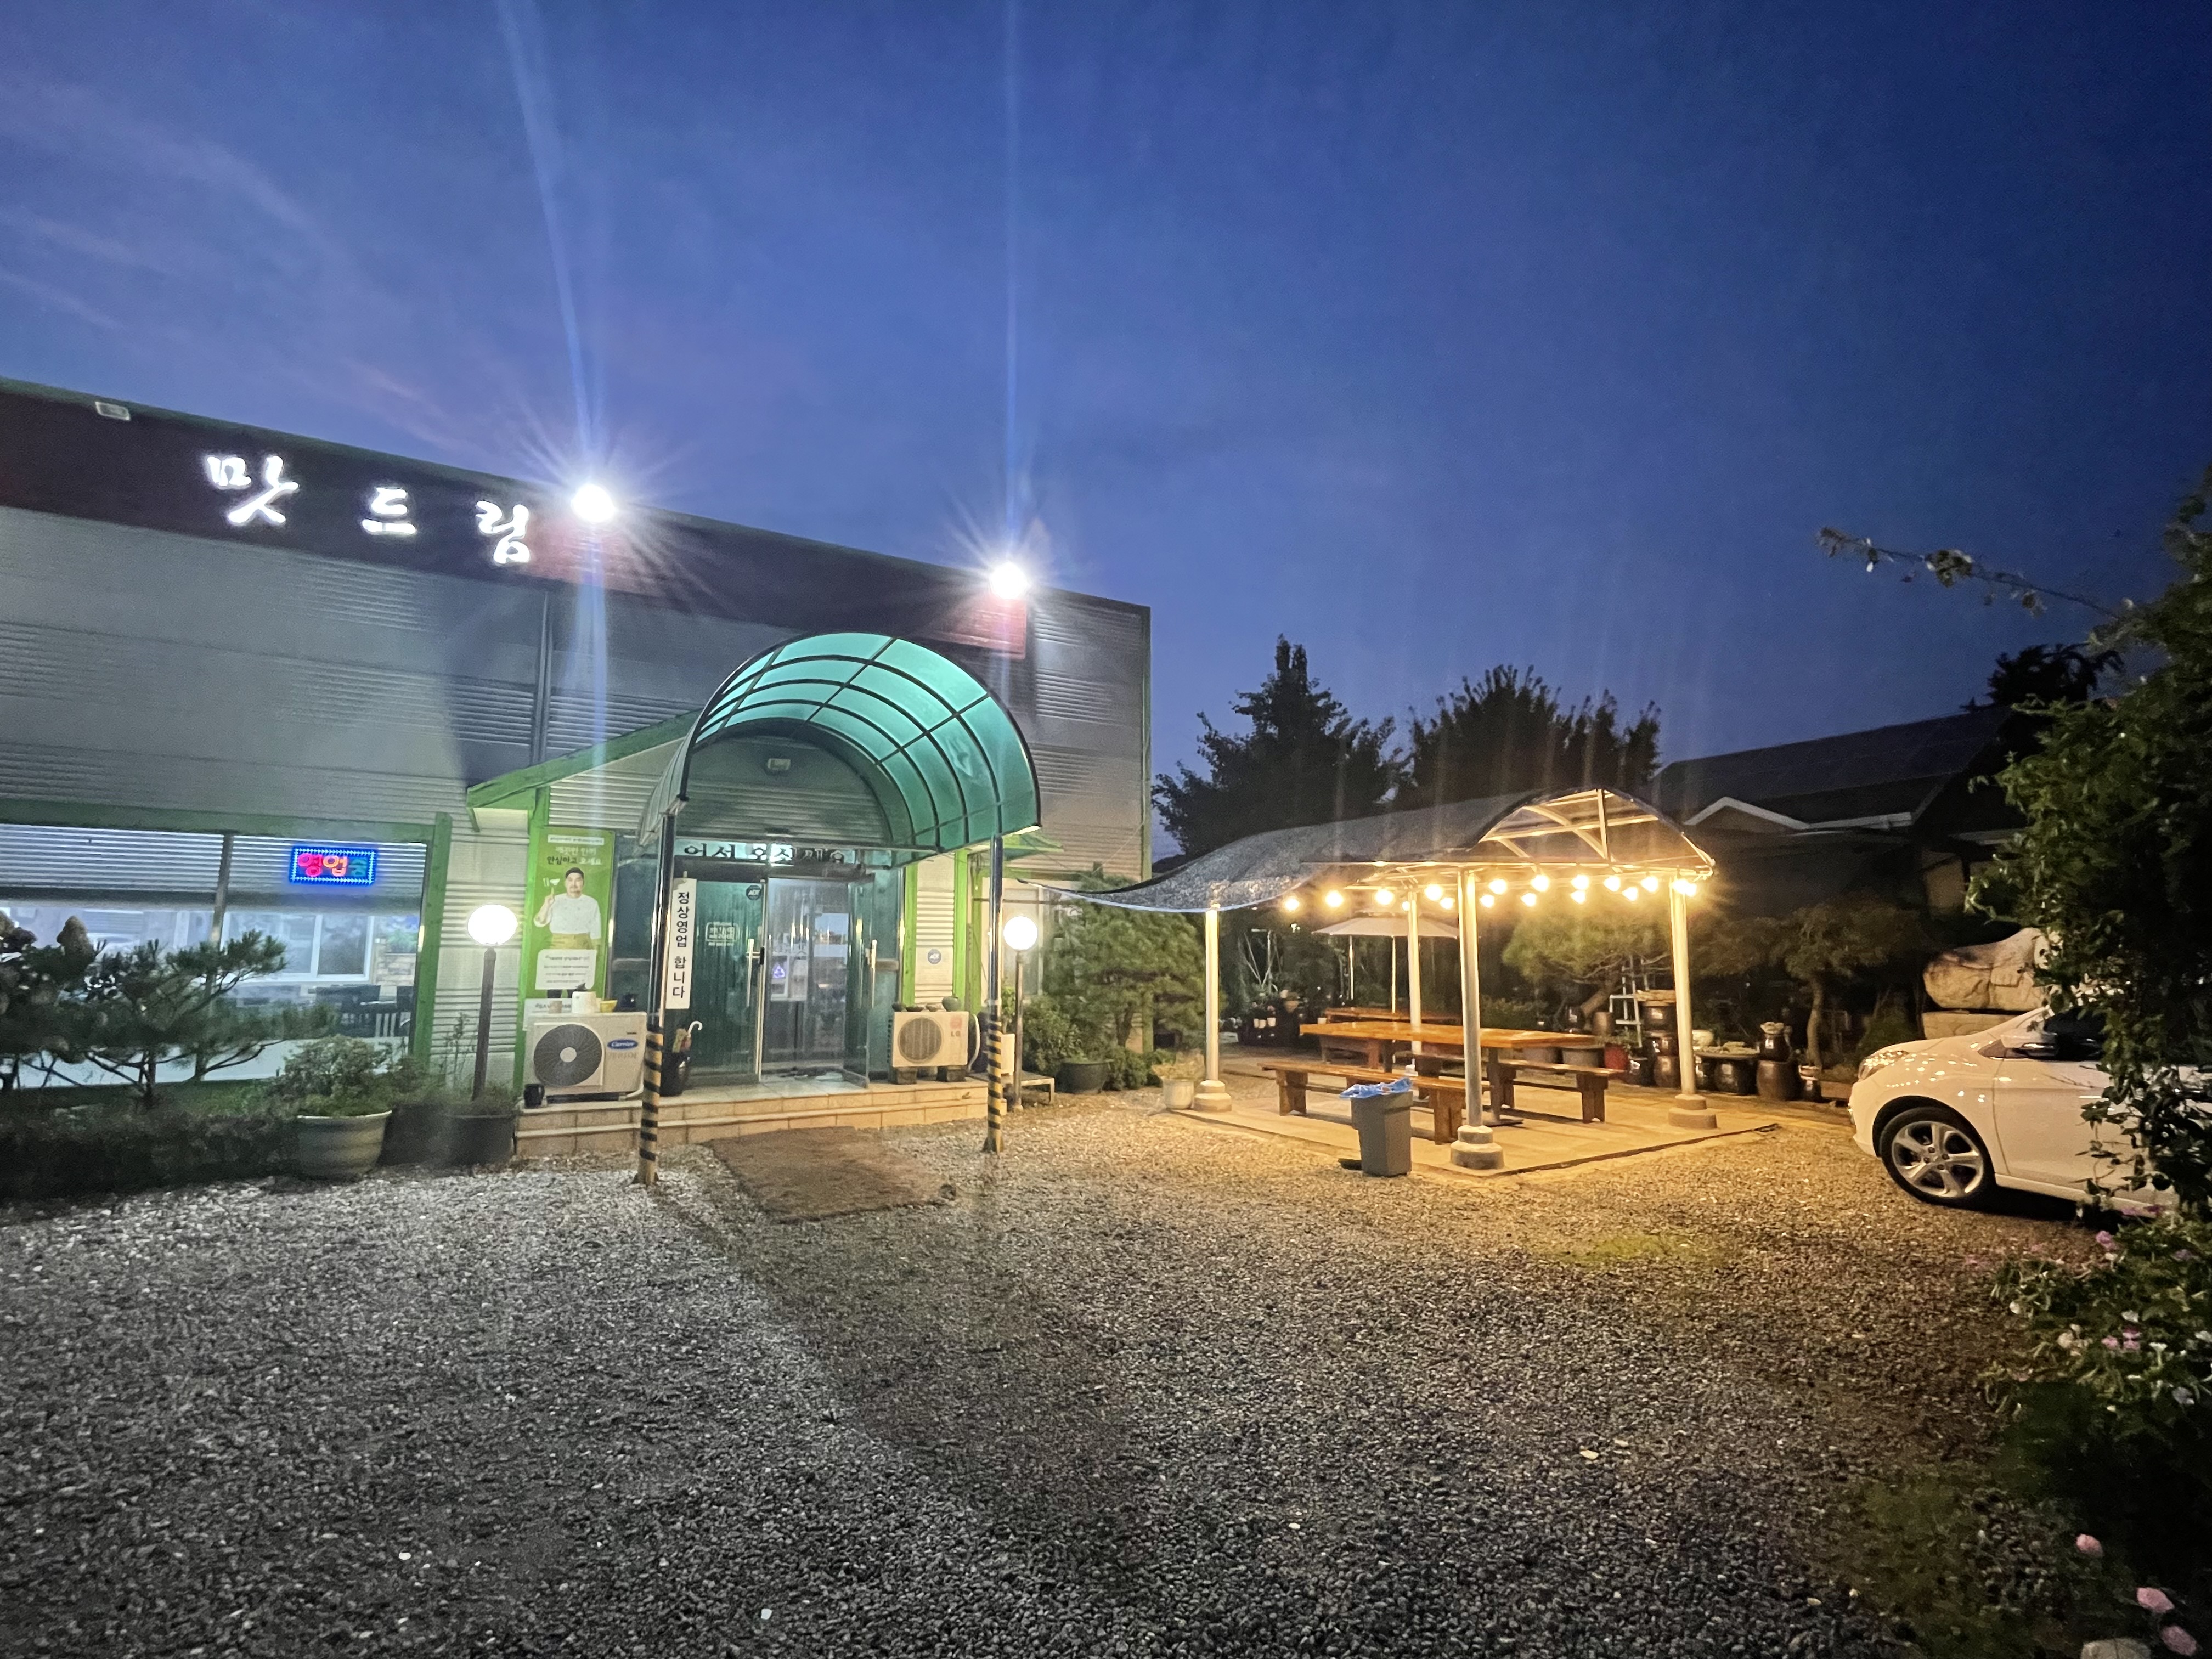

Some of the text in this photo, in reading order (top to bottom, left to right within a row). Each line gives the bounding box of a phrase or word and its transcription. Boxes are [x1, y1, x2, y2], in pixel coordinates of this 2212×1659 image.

[684, 843, 736, 859] 어서
[298, 853, 368, 877] 영업중
[673, 891, 690, 998] 정상영업 합니다
